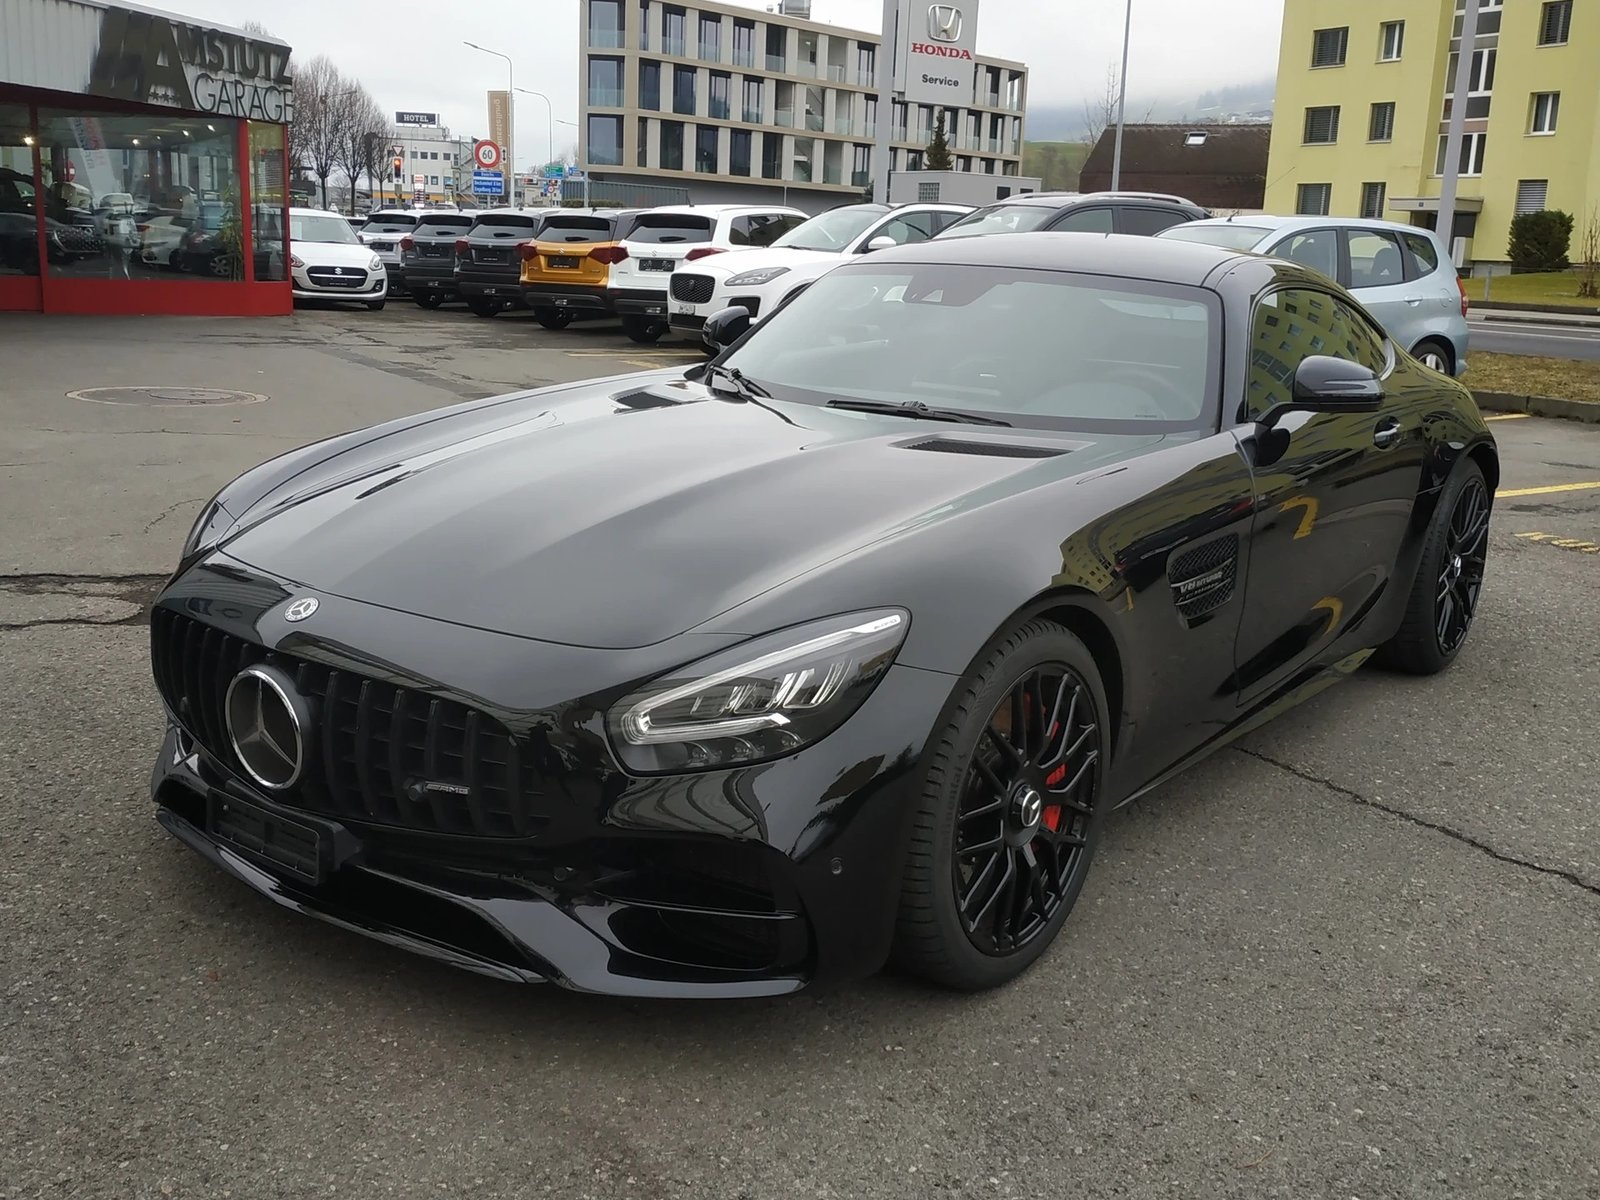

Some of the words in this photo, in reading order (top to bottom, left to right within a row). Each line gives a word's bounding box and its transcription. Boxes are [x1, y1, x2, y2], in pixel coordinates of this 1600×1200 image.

[911, 42, 972, 60] HONDA
[921, 73, 960, 87] Service
[194, 72, 293, 123] GARAGE
[403, 114, 428, 123] HOTEL
[482, 149, 493, 160] 60
[439, 785, 469, 795] AMG
